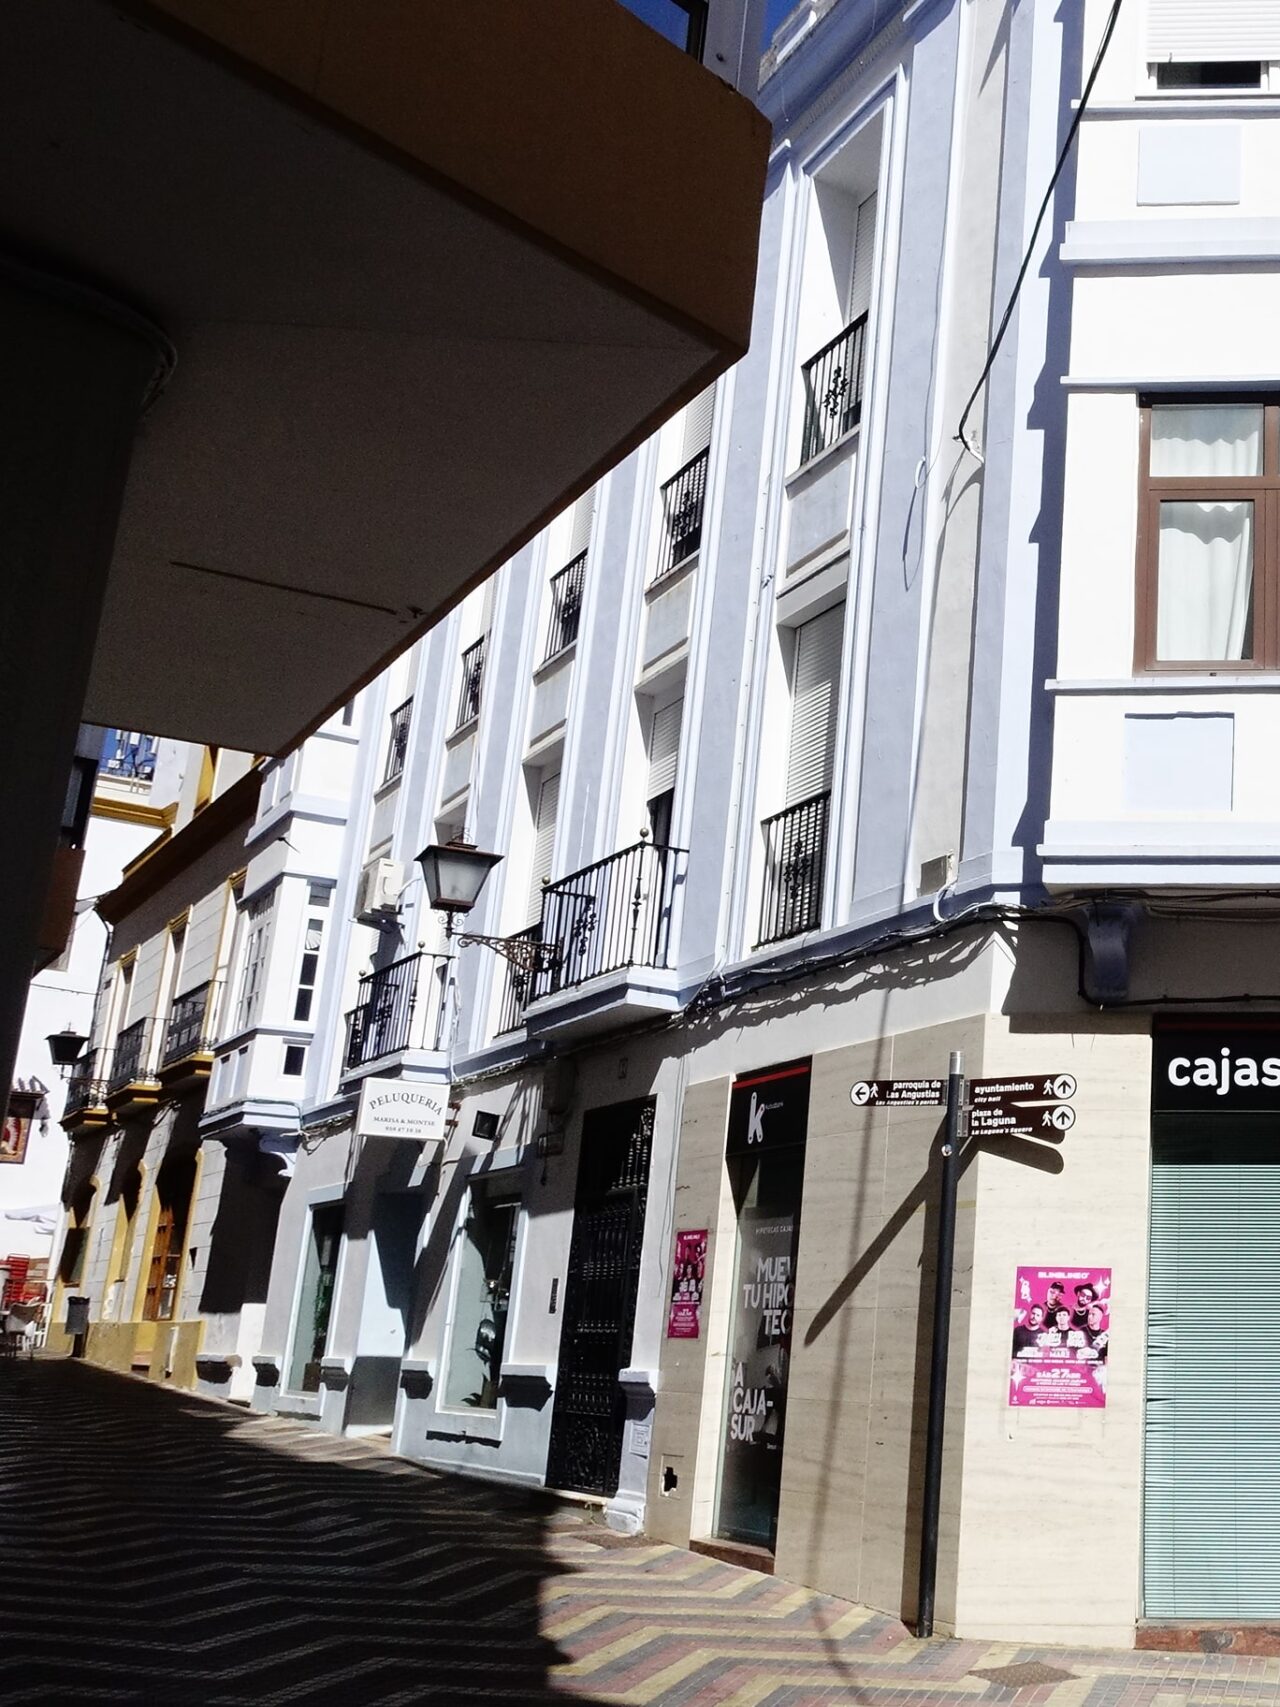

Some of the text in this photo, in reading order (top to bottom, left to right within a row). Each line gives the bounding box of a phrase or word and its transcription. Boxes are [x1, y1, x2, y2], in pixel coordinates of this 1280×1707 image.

[893, 1081, 941, 1091] parroquia de
[901, 1090, 940, 1099] Angustias
[974, 1082, 1035, 1094] ayuntamiento
[369, 1092, 443, 1116] PELUQUERIA
[971, 1108, 1003, 1118] plaza de
[971, 1117, 1017, 1127] la Laguna
[743, 1283, 761, 1309] TU
[734, 1361, 744, 1387] A
[732, 1388, 774, 1416] CAJA-
[730, 1413, 756, 1442] SUR
